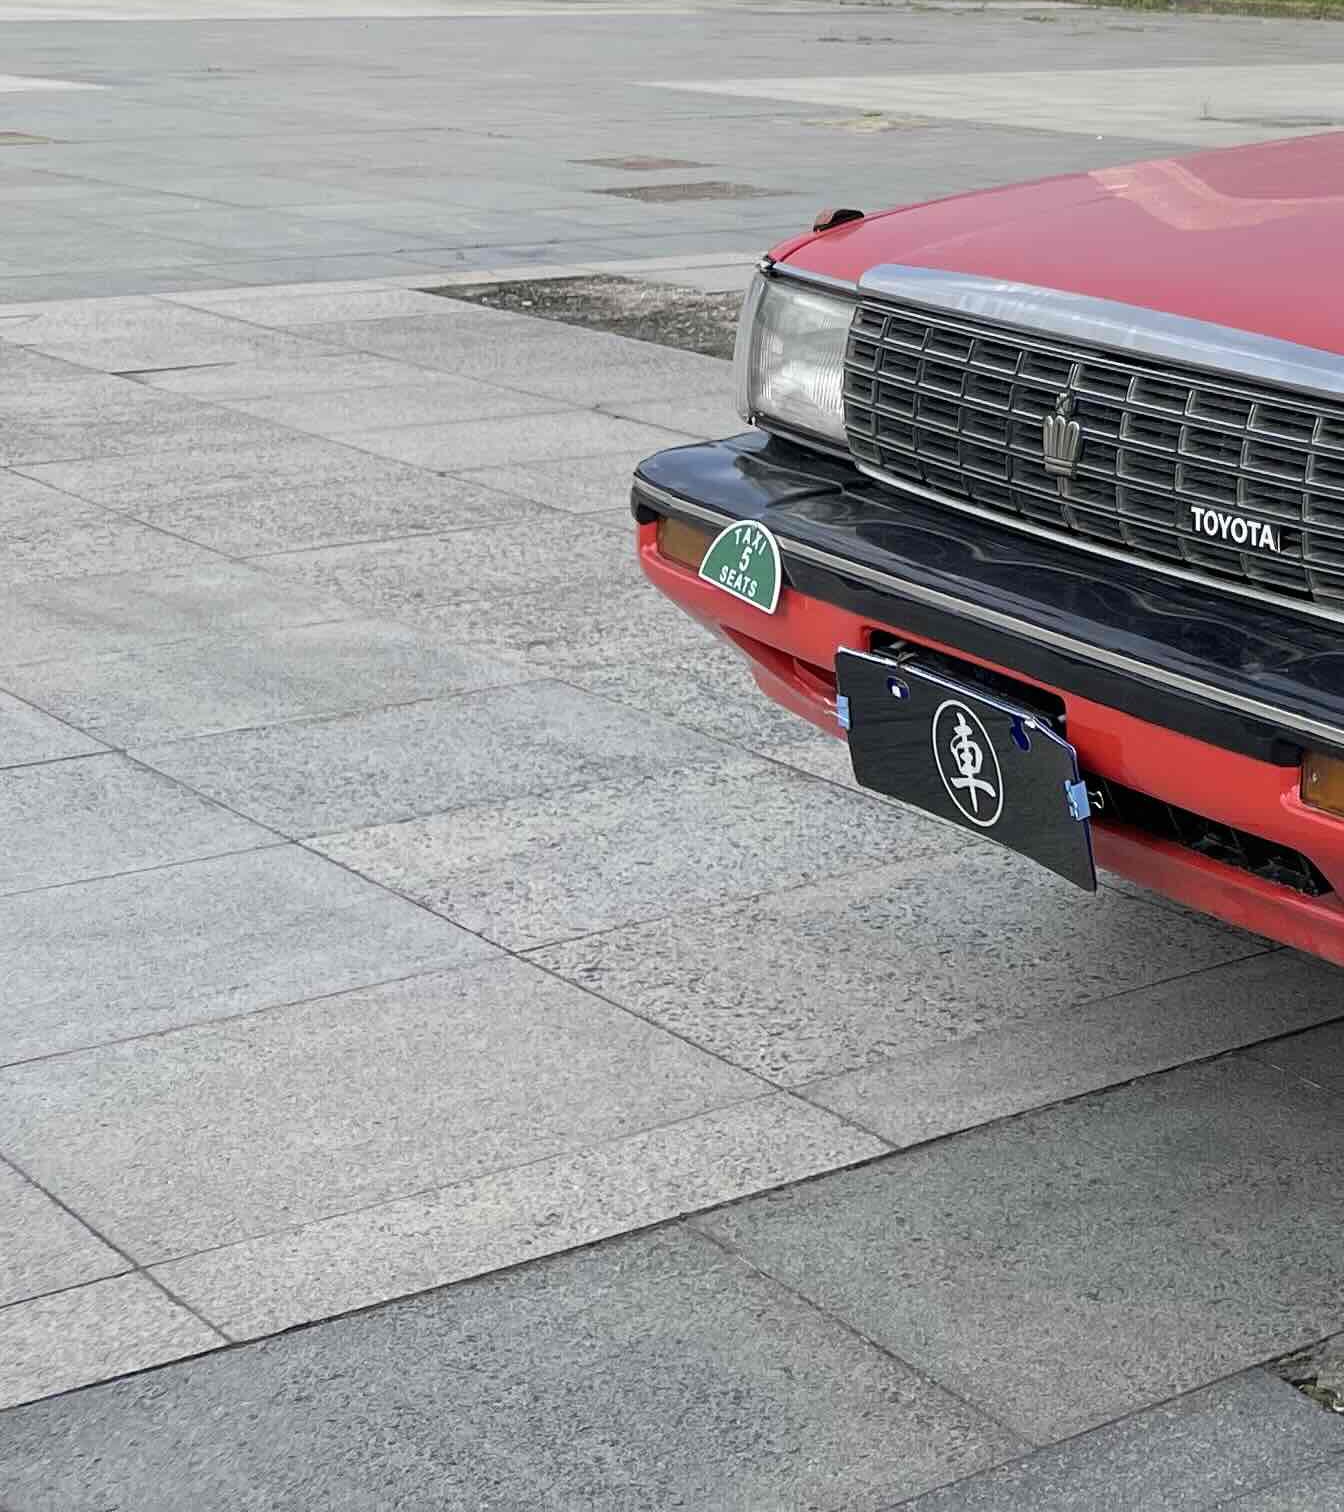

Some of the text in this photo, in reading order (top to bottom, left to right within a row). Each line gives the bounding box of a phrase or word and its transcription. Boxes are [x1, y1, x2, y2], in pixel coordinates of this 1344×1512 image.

[734, 527, 767, 555] TAXI
[1190, 506, 1278, 552] TOYOTA
[739, 546, 752, 571] 5
[719, 565, 757, 598] SEATS
